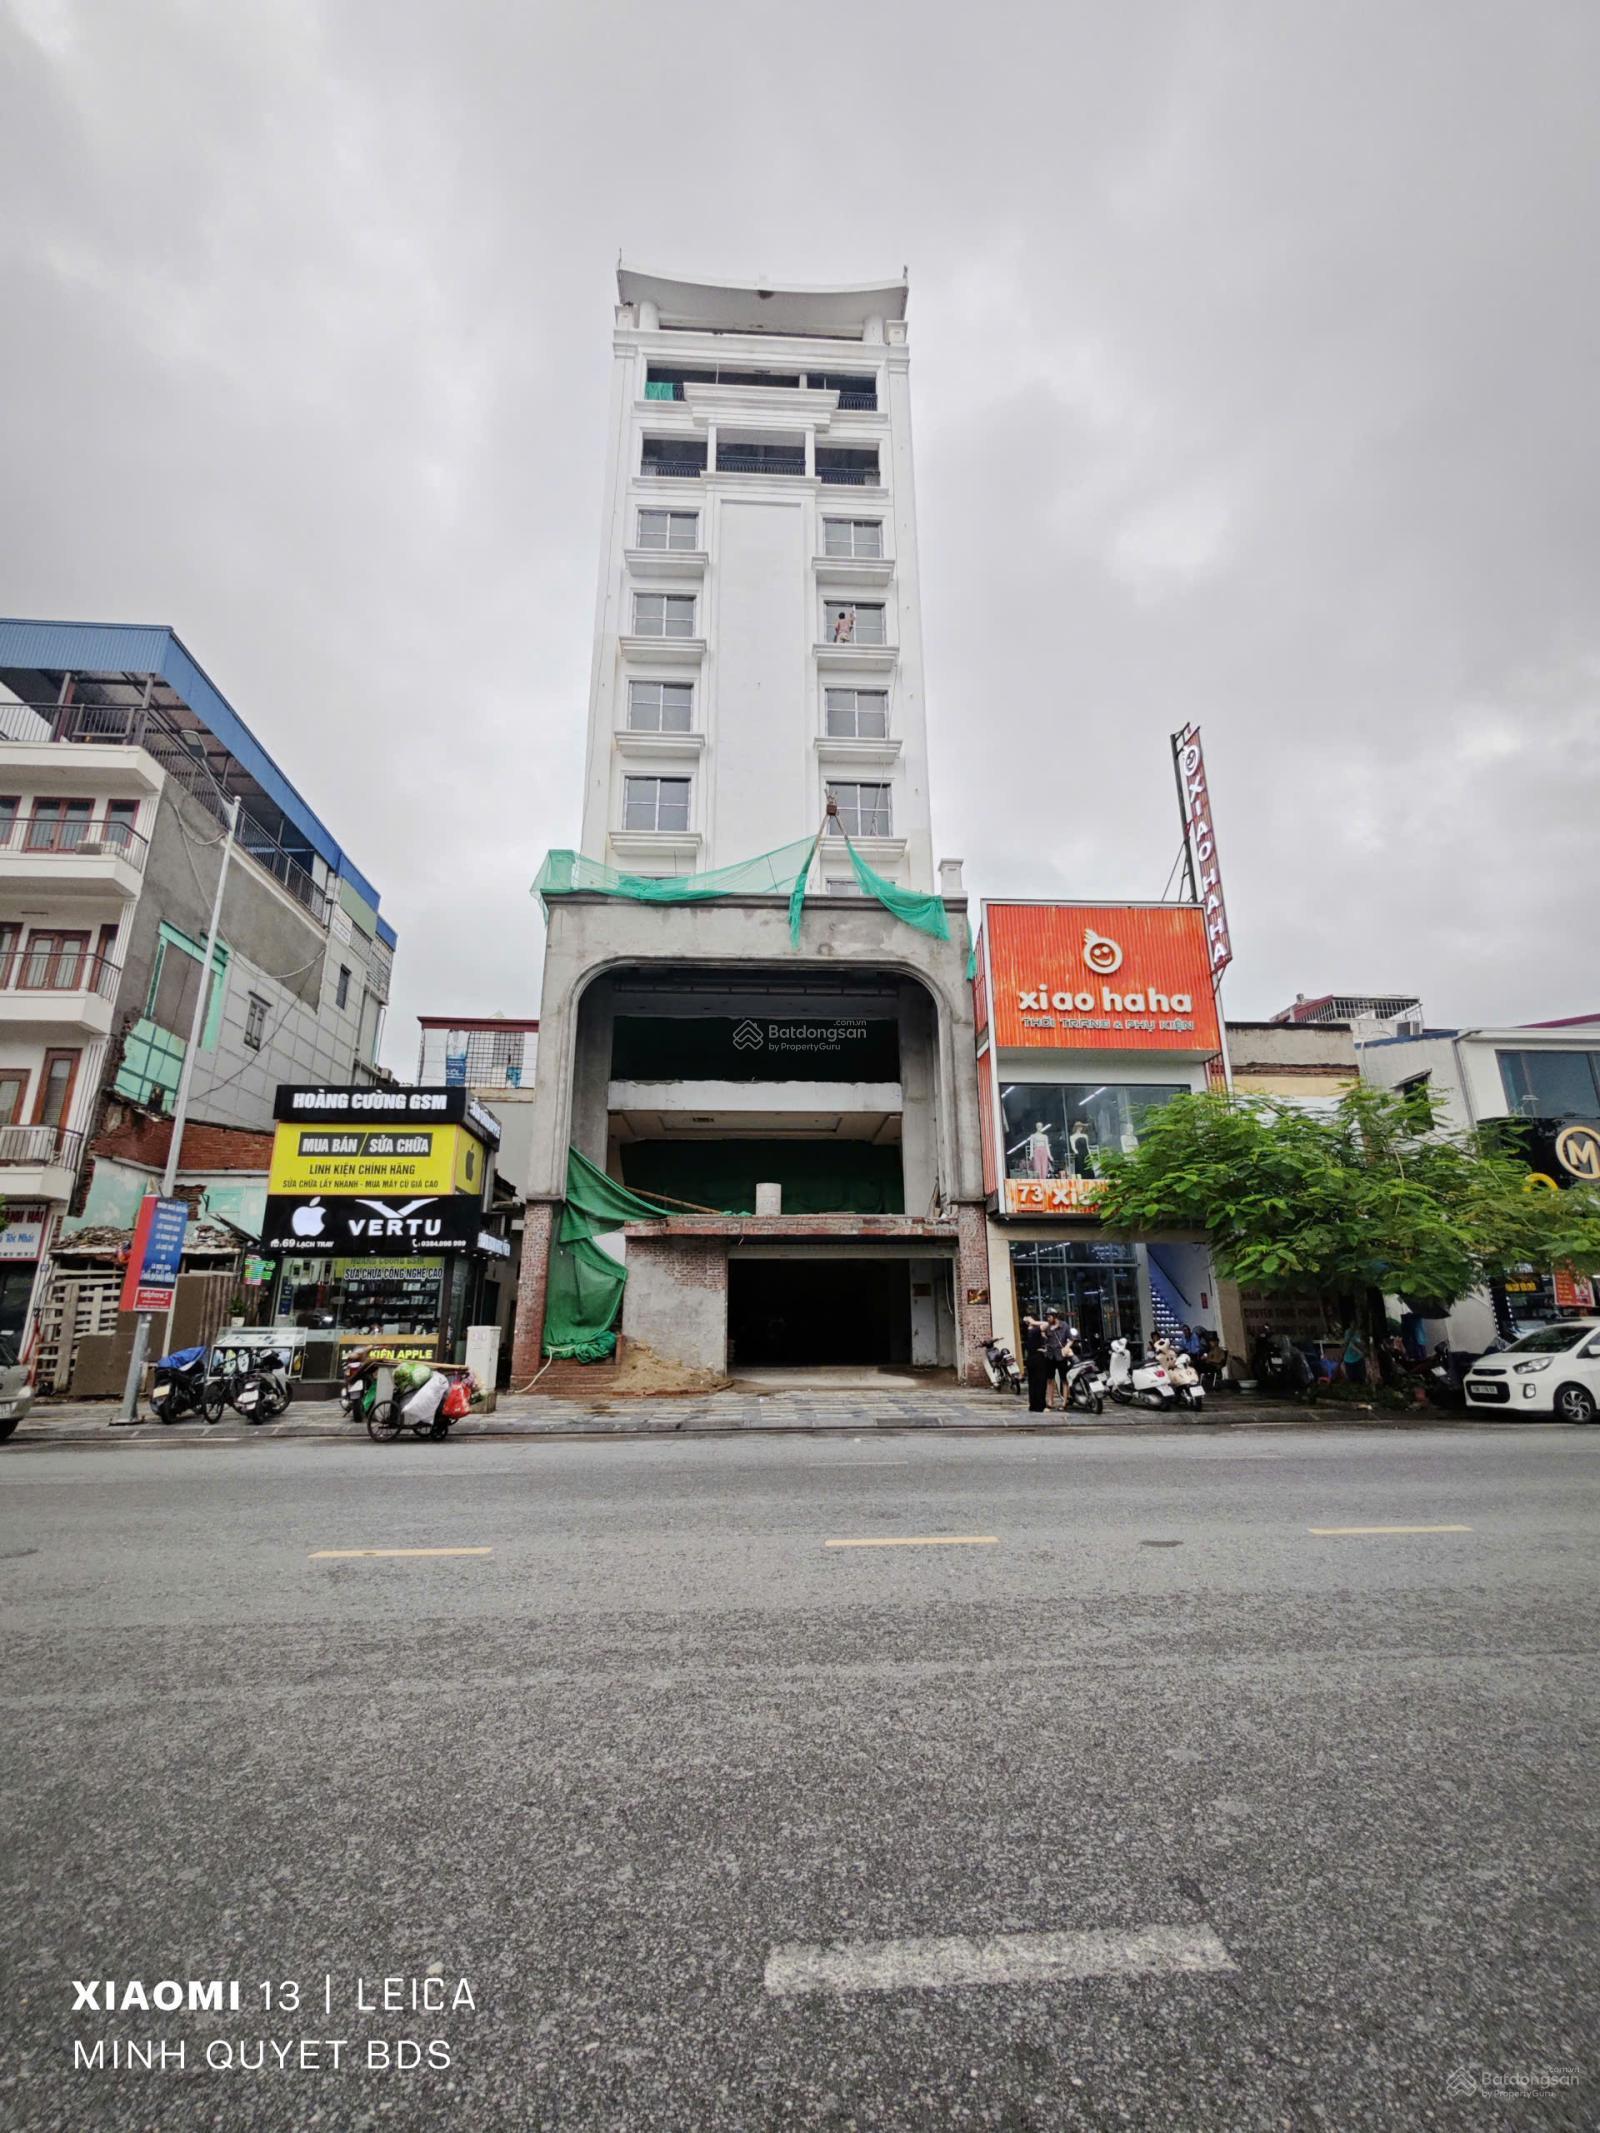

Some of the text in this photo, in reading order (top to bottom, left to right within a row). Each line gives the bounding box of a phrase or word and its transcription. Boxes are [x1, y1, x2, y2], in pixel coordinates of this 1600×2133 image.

[1019, 983, 1192, 1013] xiao haha
[1060, 1018, 1110, 1029] TRANG
[1125, 1019, 1155, 1032] PHỤ
[1159, 1017, 1195, 1032] KIỆN
[292, 1088, 447, 1110] HOÀNG CƯỜNG GSM
[302, 1135, 428, 1153] MUA BÁN SỬA CHỮA
[309, 1164, 331, 1174] LINH
[334, 1162, 356, 1177] KIỆN
[358, 1162, 387, 1174] CHÍNH
[334, 1180, 358, 1188] NHANH
[365, 1180, 380, 1188] MUA
[424, 1180, 439, 1188] CAO
[1018, 1185, 1044, 1203] 73
[348, 1218, 442, 1236] VERTU
[427, 1267, 443, 1280] CAO
[397, 1349, 433, 1359] APPLE
